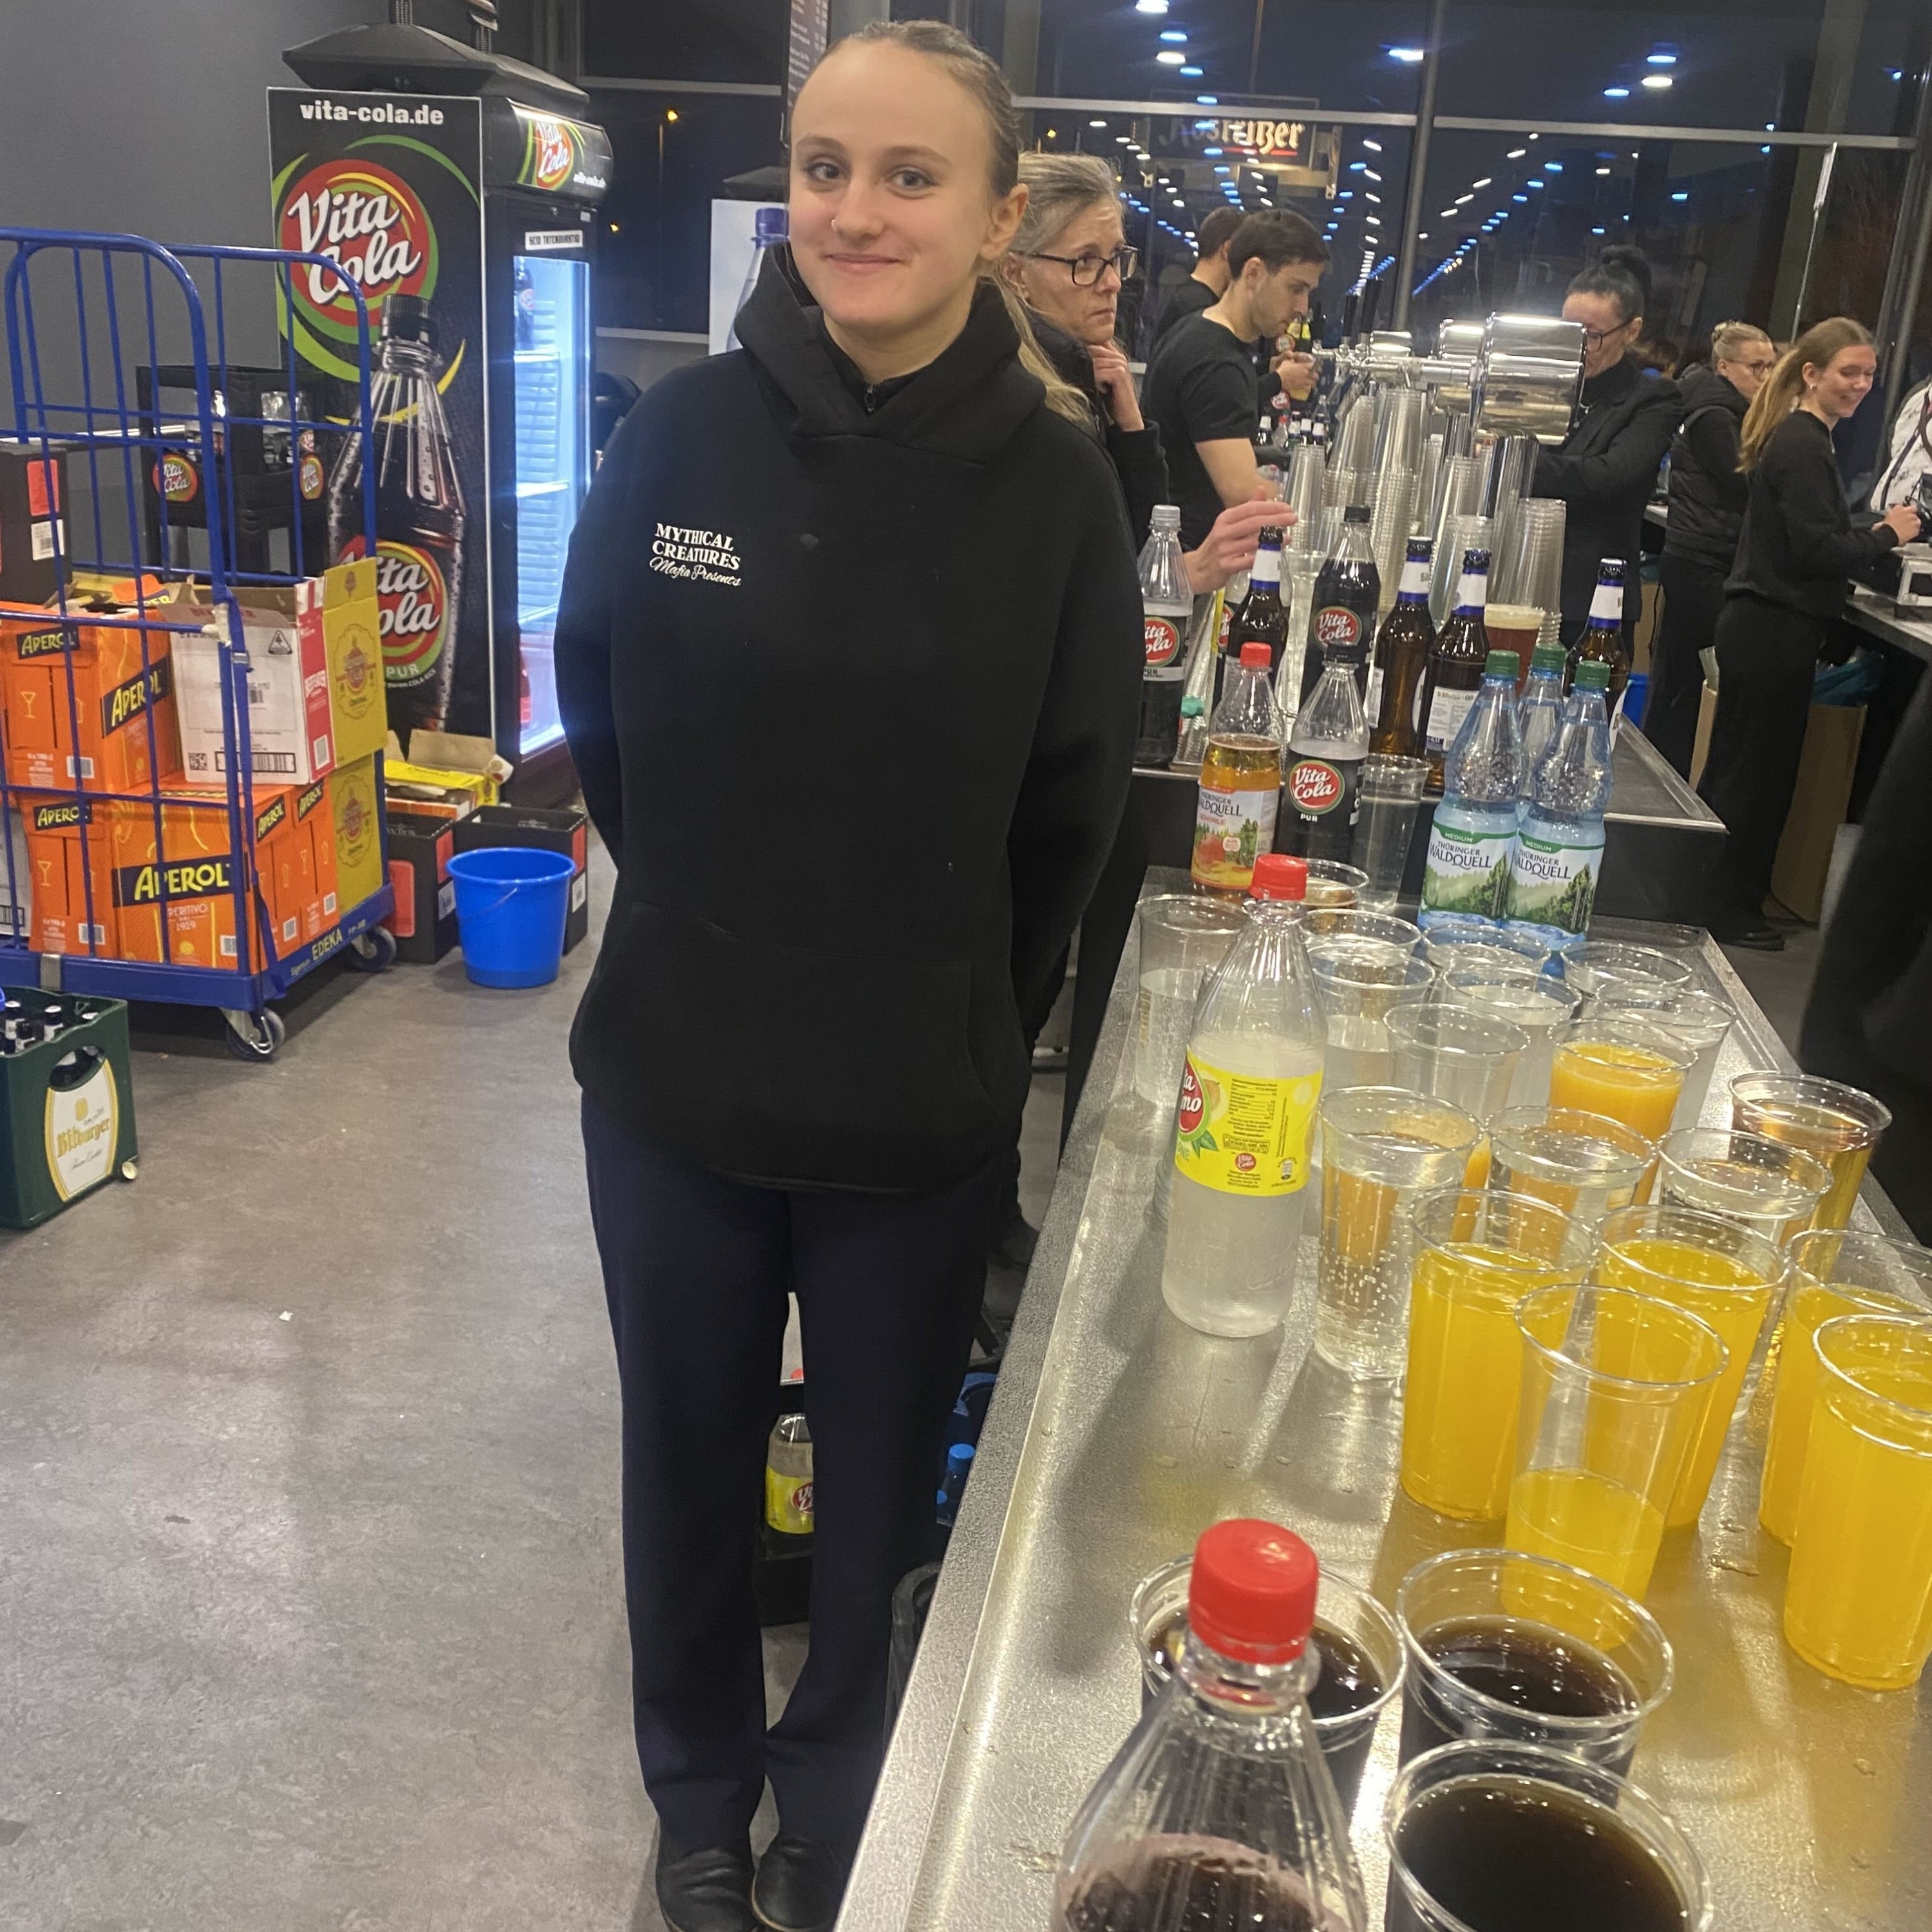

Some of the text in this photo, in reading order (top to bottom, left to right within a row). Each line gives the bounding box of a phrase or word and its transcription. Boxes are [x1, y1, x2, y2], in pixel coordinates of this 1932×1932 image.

[300, 100, 444, 124] vita-cola.de
[538, 142, 570, 178] Cola
[288, 188, 400, 252] Vita
[308, 229, 421, 304] Cola
[164, 476, 191, 493] Cola
[655, 523, 734, 551] MYTHICAL
[652, 540, 741, 570] CREATURES
[649, 556, 741, 586] Mafia Presents
[379, 592, 440, 634] ola
[1319, 613, 1350, 629] Vita
[1145, 625, 1168, 639] ita
[1318, 625, 1354, 641] Cola
[1146, 636, 1172, 654] ola
[386, 663, 419, 678] PUR
[111, 671, 161, 726] APERL
[1294, 767, 1331, 785] Vita
[1294, 781, 1336, 799] Cola
[37, 806, 88, 826] APERO
[1300, 813, 1318, 822] PUR
[1444, 833, 1473, 842] MEDIUM
[1526, 840, 1552, 852] MEDIUM
[1430, 842, 1492, 870] WALDQUELL
[1438, 840, 1481, 856] THÜRINGER
[1519, 849, 1559, 866] THÜRINGER
[167, 904, 207, 917] PERITIVO
[312, 929, 343, 960] EDEKA
